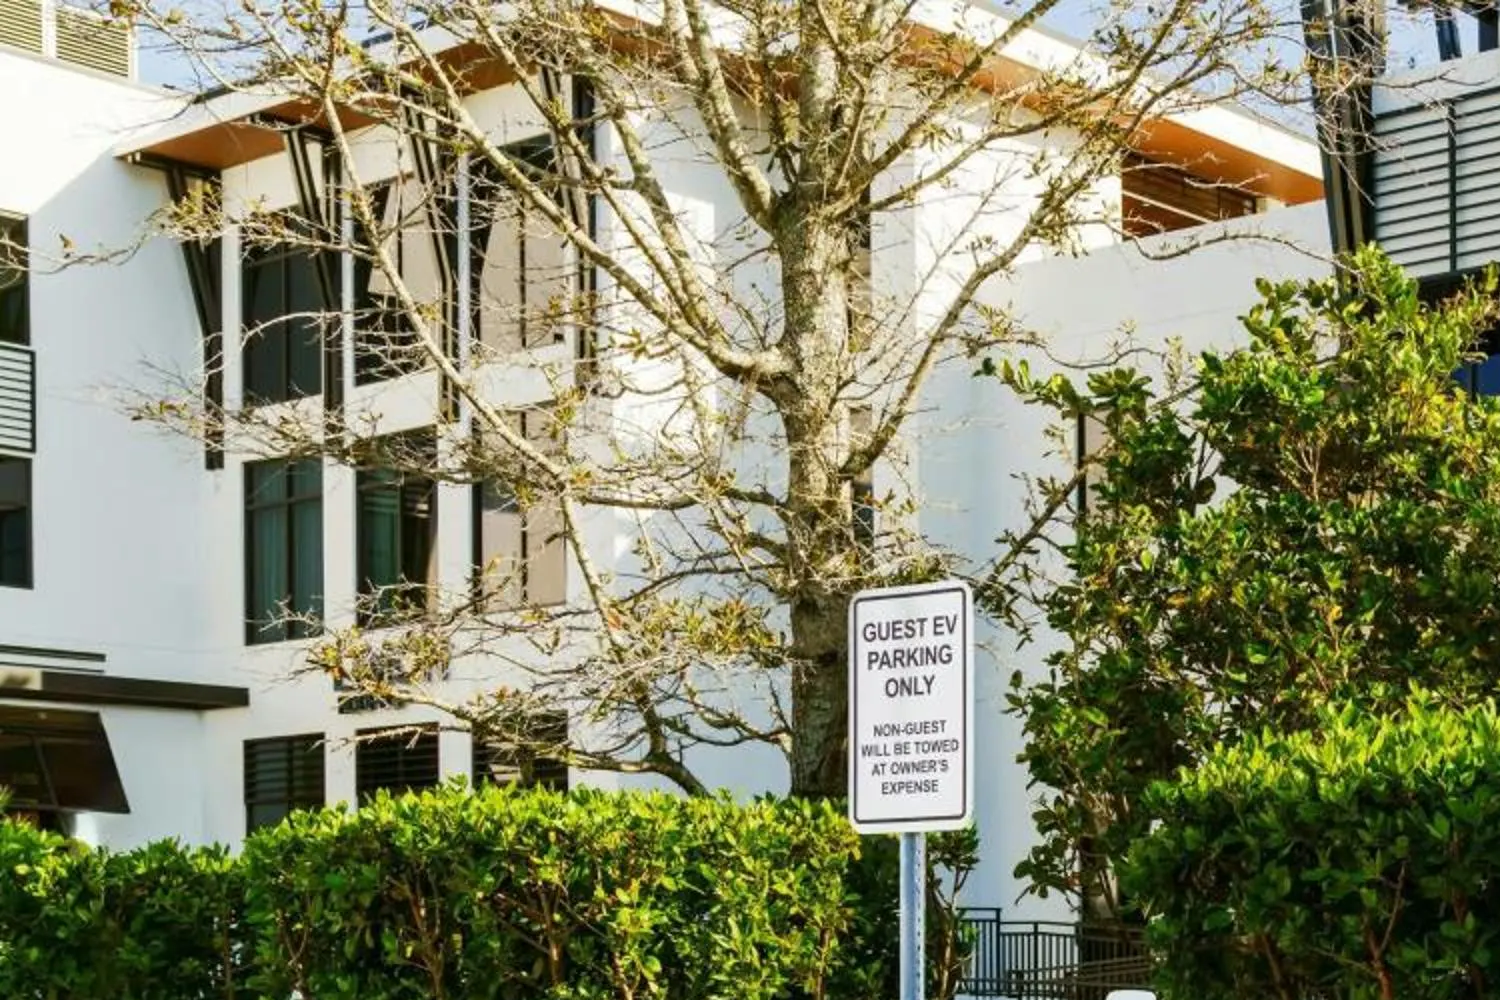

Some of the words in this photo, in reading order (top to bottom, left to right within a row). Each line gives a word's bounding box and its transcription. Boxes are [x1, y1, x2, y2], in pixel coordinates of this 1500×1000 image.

[862, 617, 928, 643] GUEST
[933, 615, 958, 636] EV
[867, 644, 953, 670] PARKING
[885, 675, 935, 698] ONLY
[873, 720, 947, 738] NON-GUEST
[861, 743, 890, 758] WILL
[893, 742, 910, 756] BE
[914, 739, 959, 754] TOWED
[871, 763, 886, 777] AT
[881, 779, 939, 795] EXPENSE
